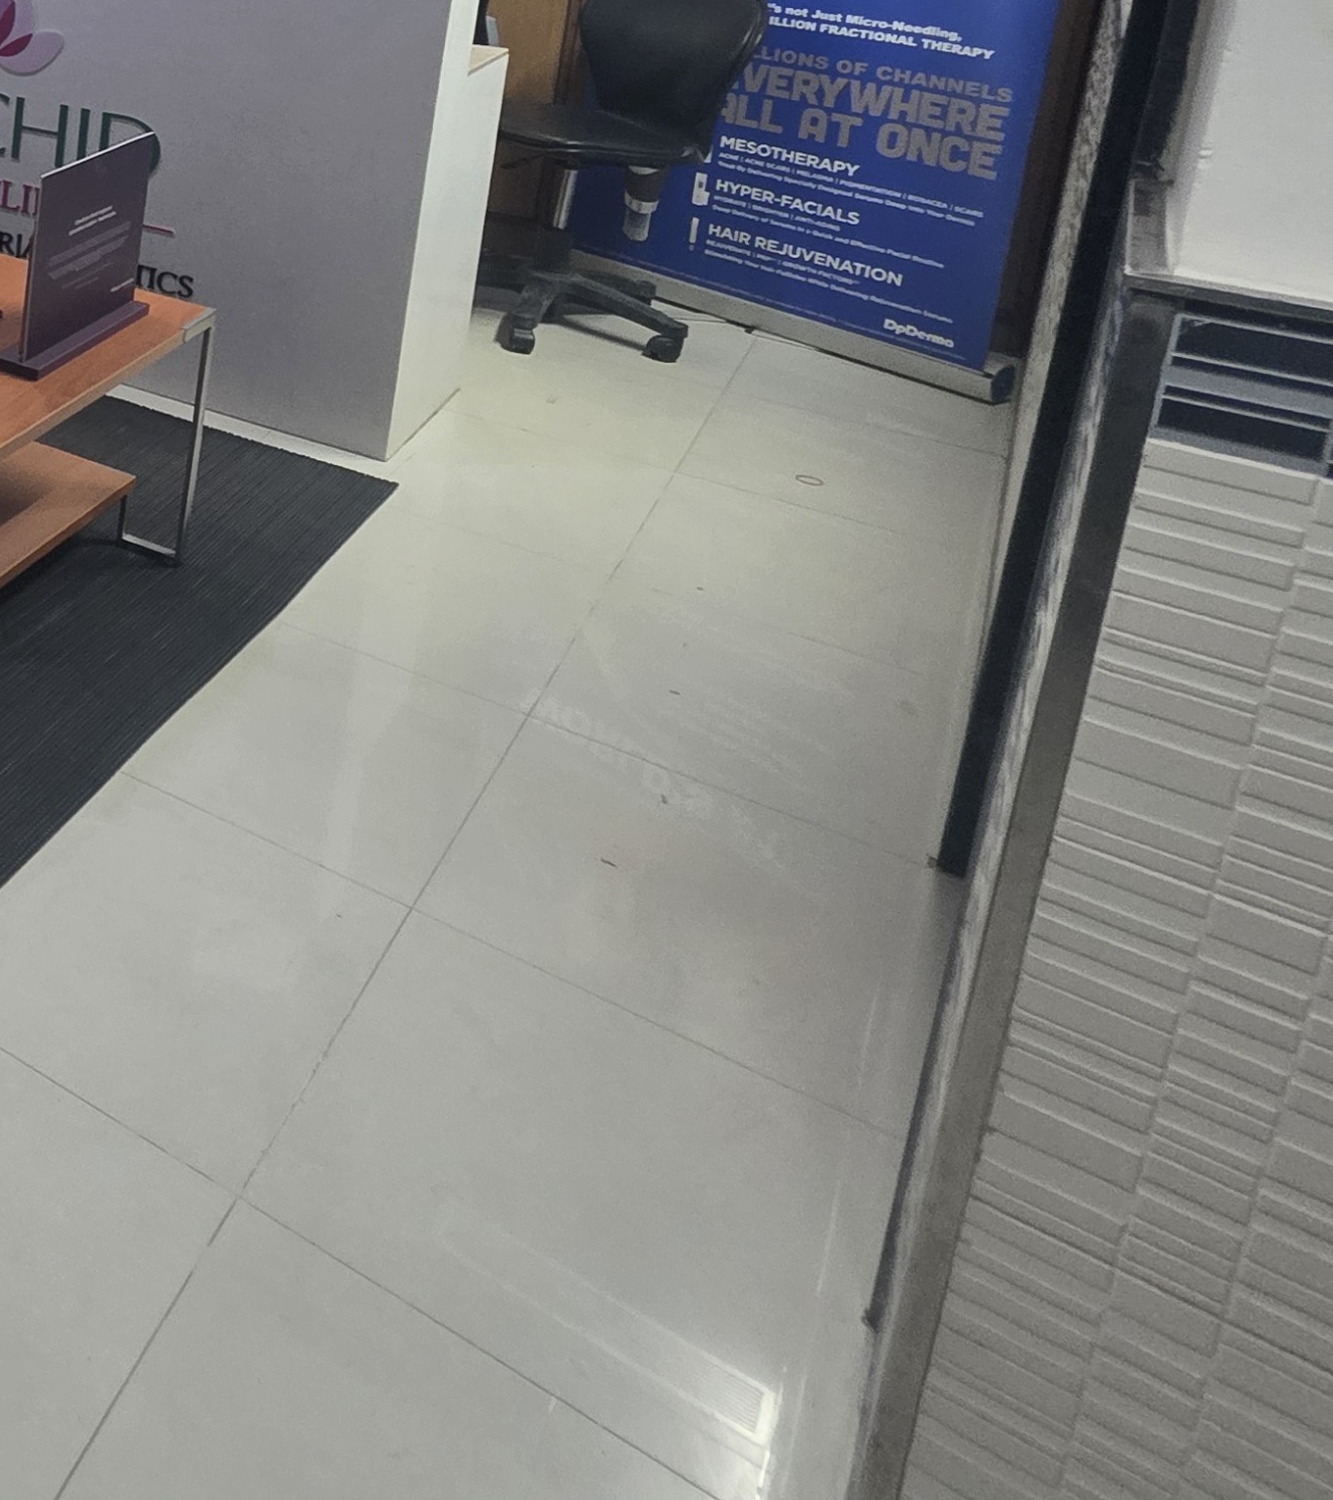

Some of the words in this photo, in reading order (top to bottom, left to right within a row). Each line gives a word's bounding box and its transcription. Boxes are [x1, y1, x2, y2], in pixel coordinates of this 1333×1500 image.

[785, 6, 808, 18] not
[811, 9, 843, 23] Just
[769, 16, 817, 32] ILLION
[820, 23, 918, 47] FRACTIONAL
[921, 38, 995, 60] THERAPY
[733, 64, 1011, 141] VERYWHERE
[836, 59, 869, 77] OF
[876, 66, 1014, 102] CHANNELS
[720, 135, 860, 177] MESOTHERAPY
[798, 108, 863, 148] AT
[876, 122, 1004, 180] ONCE
[715, 179, 861, 226] HYPER-FACIALS
[708, 223, 752, 246] HAIR
[754, 236, 903, 287] REJUVENATION
